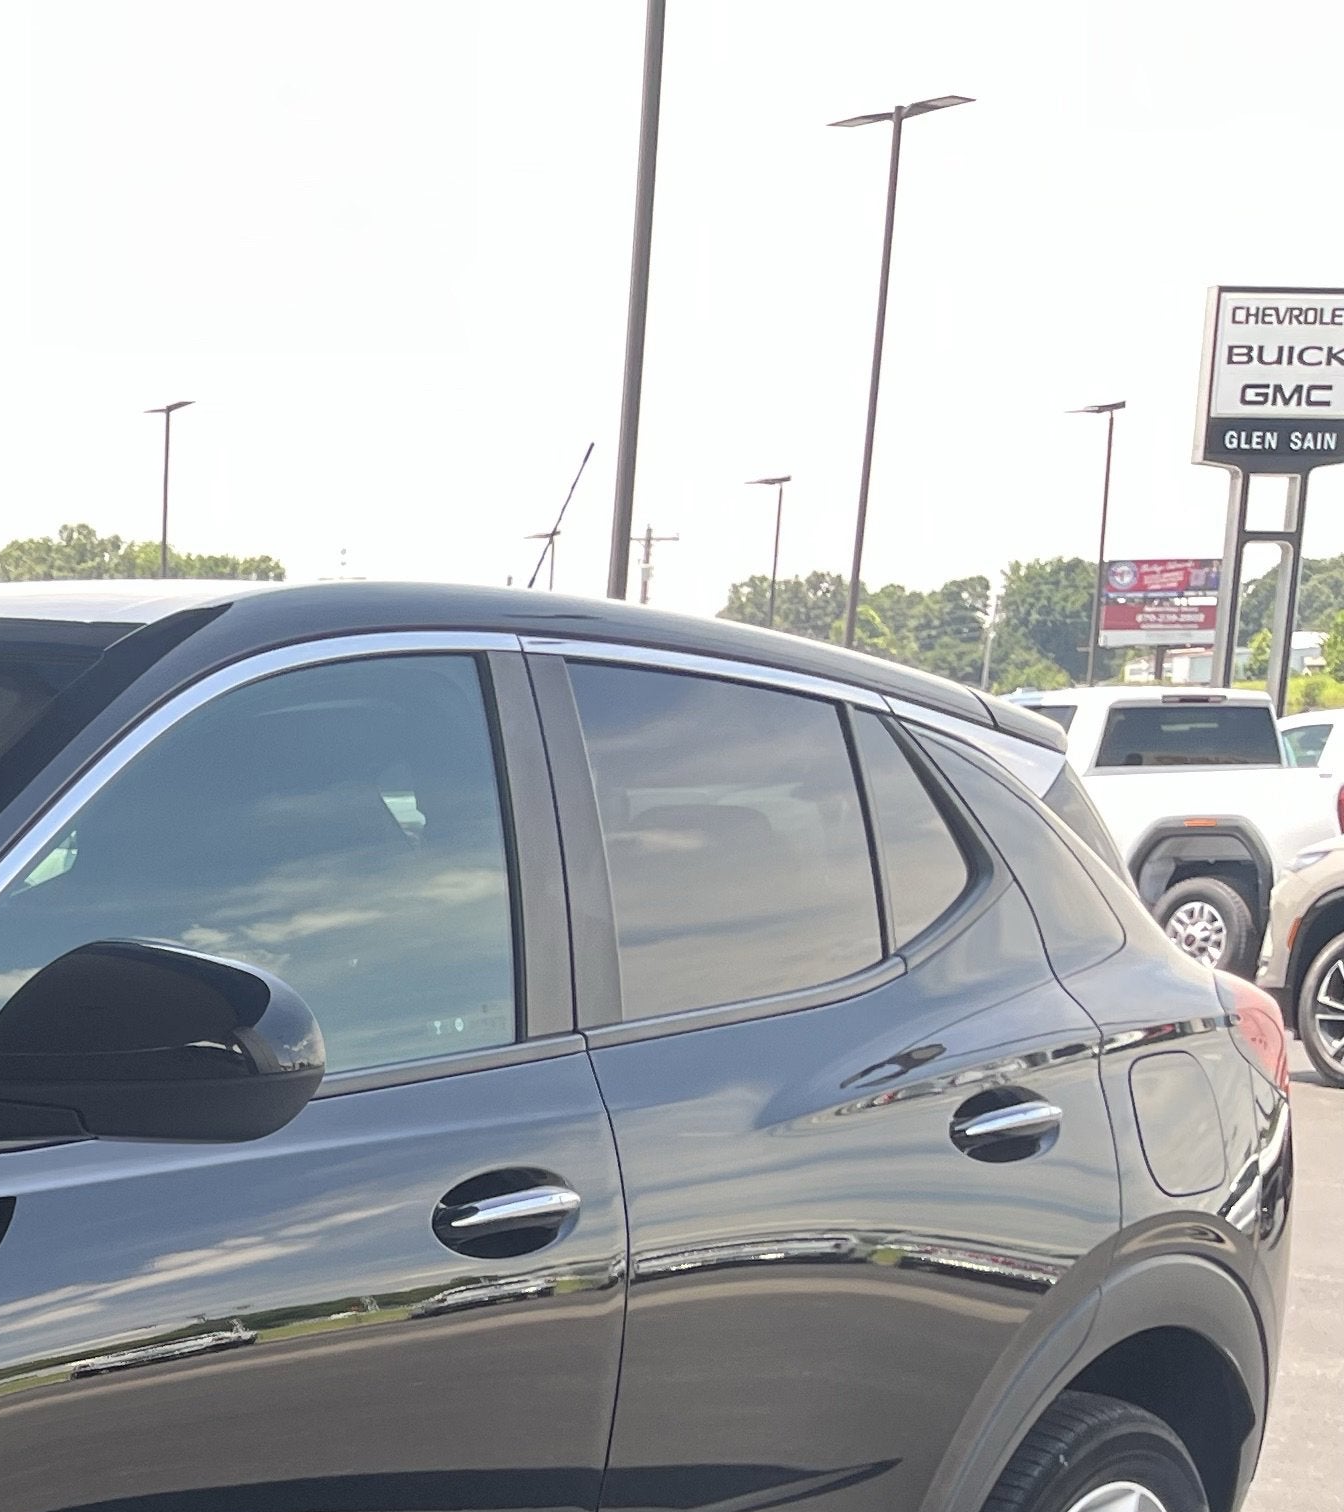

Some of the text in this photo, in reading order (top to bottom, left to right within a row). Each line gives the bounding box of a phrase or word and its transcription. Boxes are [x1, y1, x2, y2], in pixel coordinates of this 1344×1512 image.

[1227, 344, 1344, 367] BUICK
[1239, 383, 1334, 407] GMC
[1224, 430, 1338, 451] GLEN SAIN
